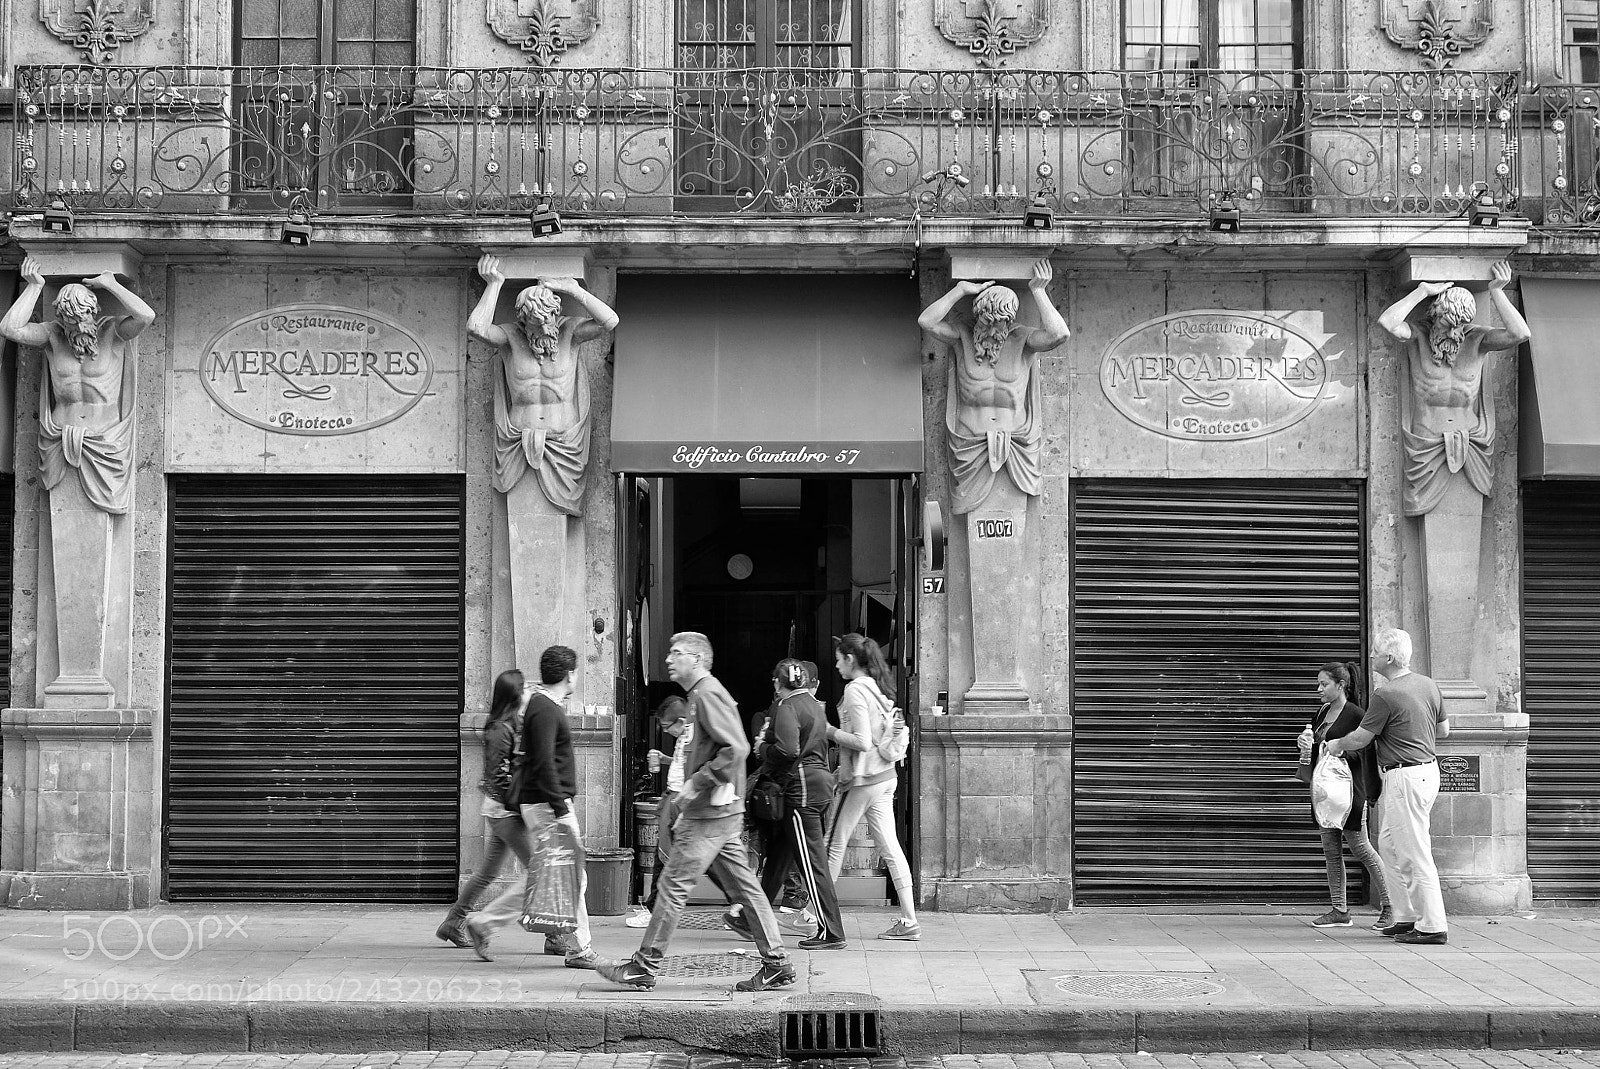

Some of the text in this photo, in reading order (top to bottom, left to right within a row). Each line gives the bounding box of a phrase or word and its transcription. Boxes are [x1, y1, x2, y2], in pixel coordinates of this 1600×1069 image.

[271, 315, 366, 334] Restaurante
[1172, 319, 1268, 340] Restaurante
[211, 349, 436, 400] MERCADERES
[1110, 355, 1337, 407] MERCADERES
[278, 412, 346, 430] Enoteca
[1182, 417, 1251, 435] Enoteca
[672, 445, 861, 469] Edificio Cantabro 57
[977, 520, 1012, 537] 1007
[923, 577, 944, 593] 57
